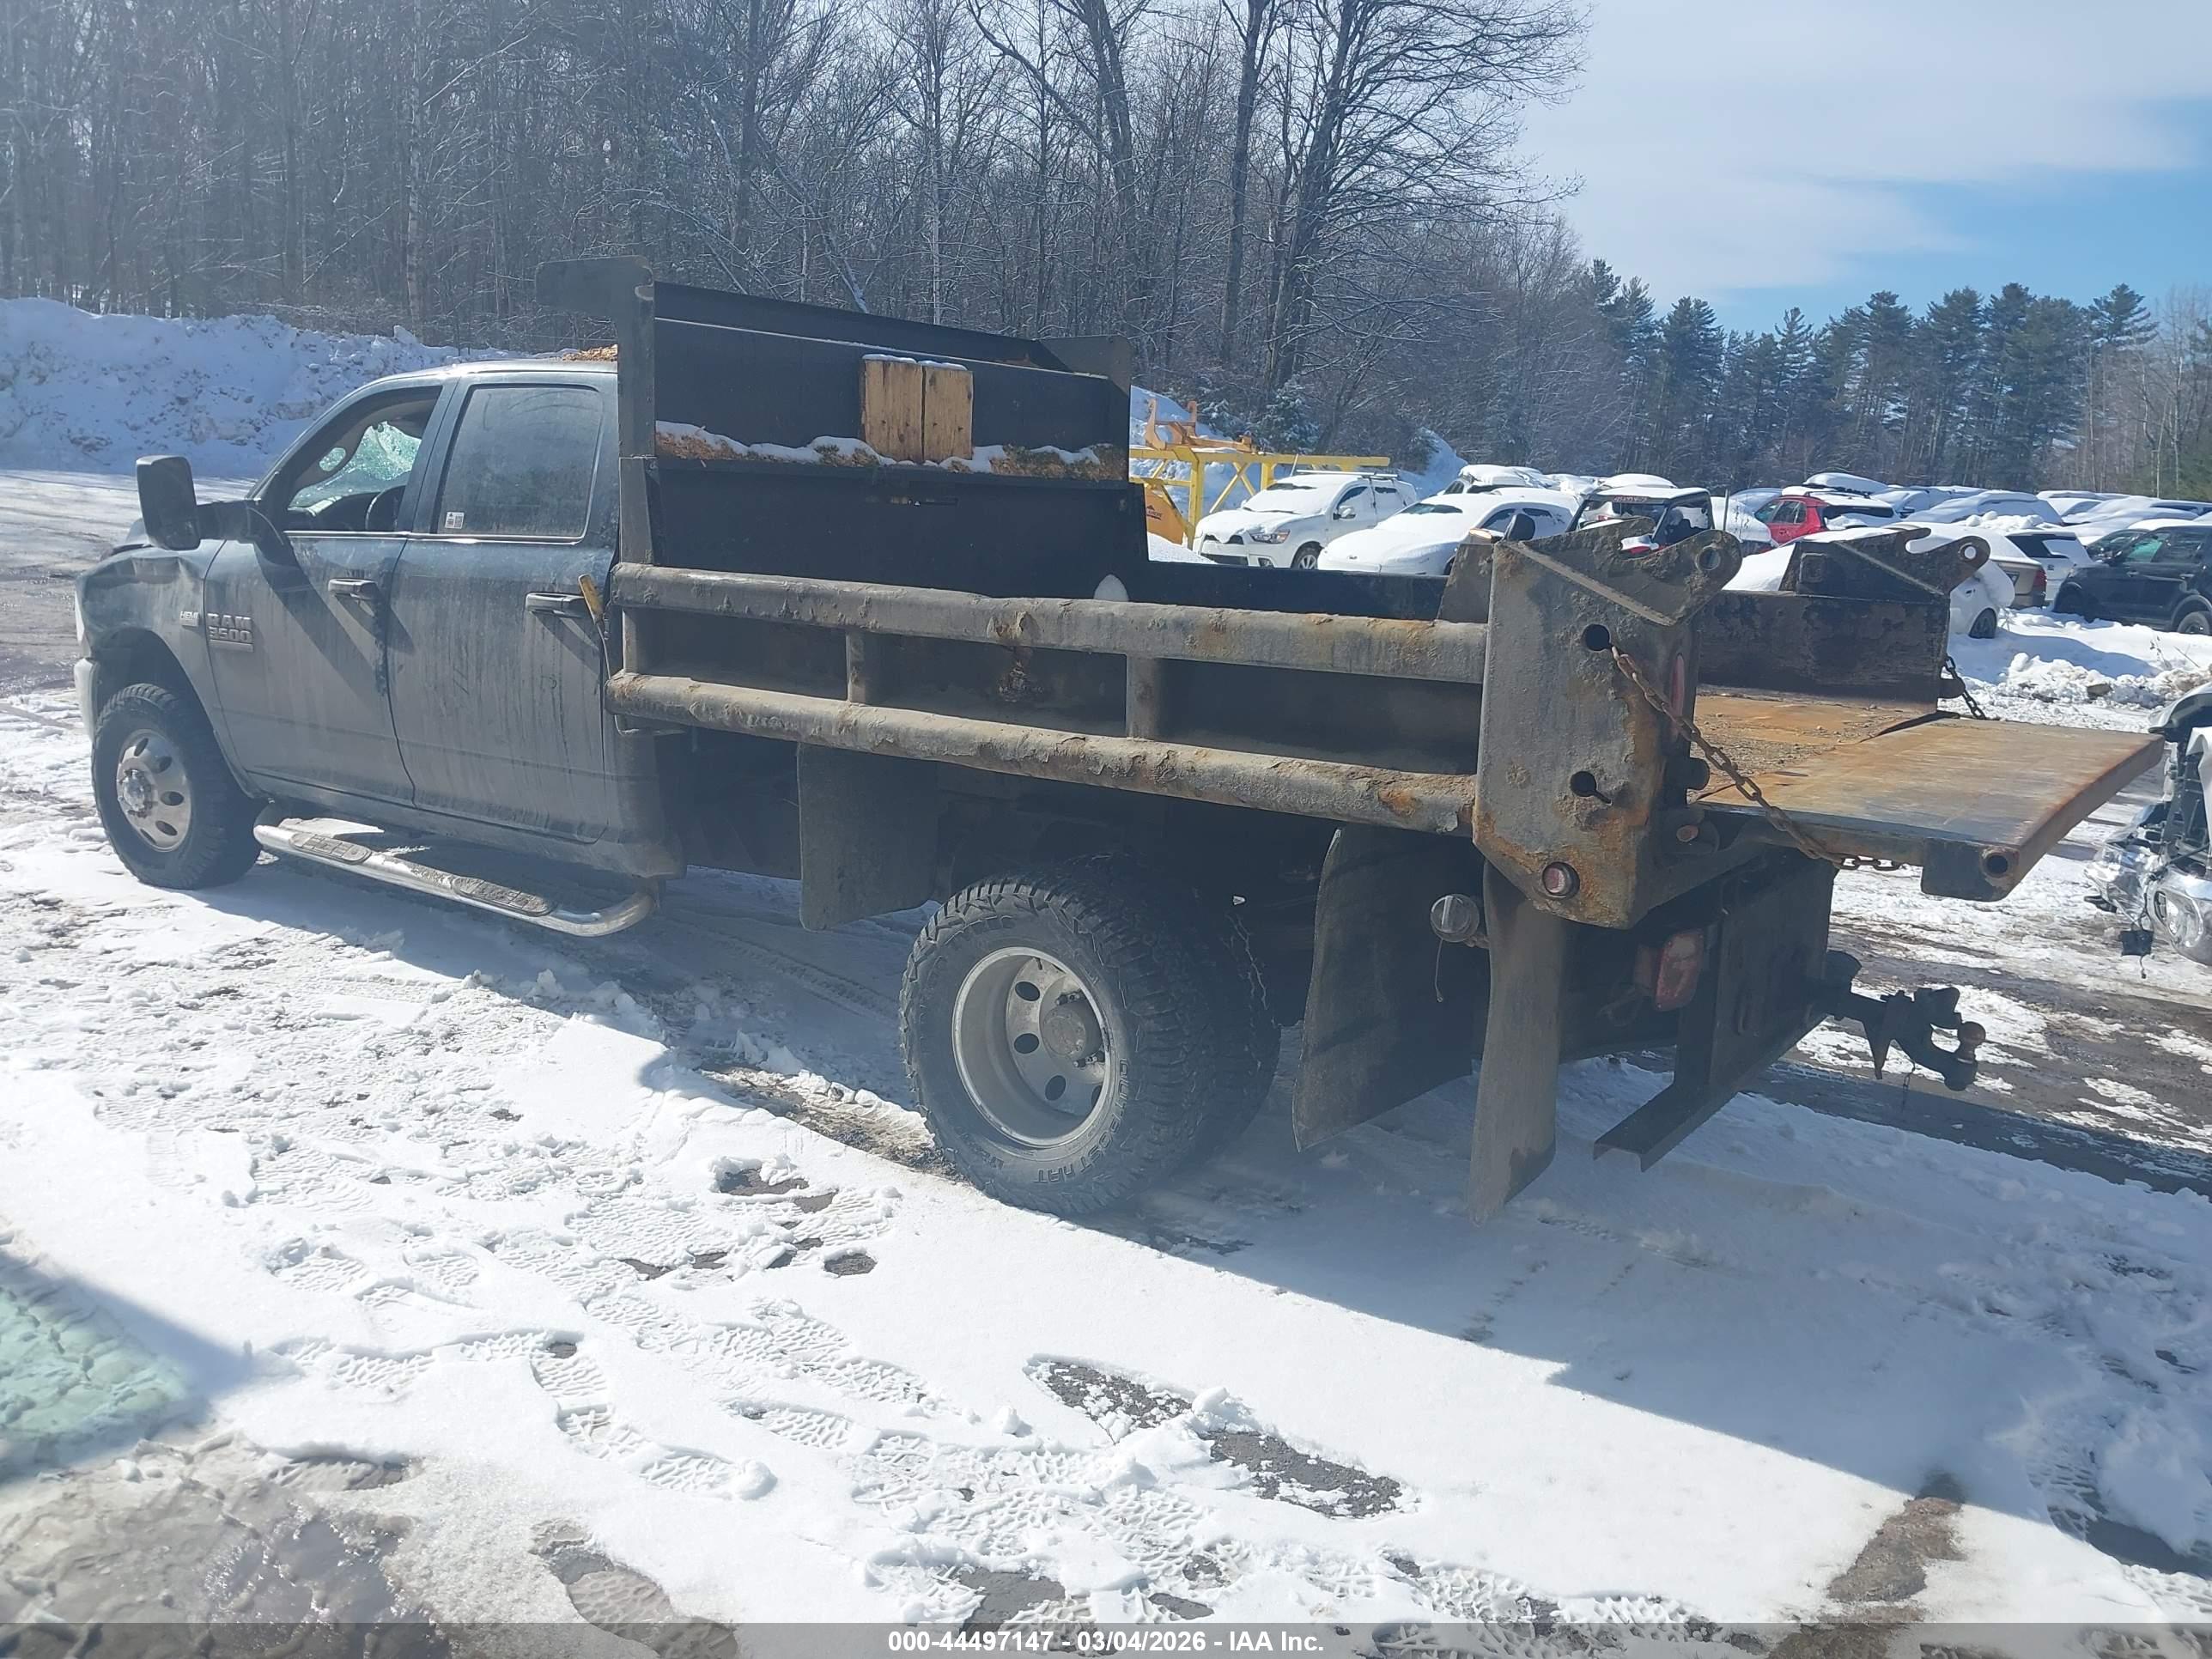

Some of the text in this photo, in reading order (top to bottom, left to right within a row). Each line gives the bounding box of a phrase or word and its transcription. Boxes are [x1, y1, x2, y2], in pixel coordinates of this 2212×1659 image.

[179, 611, 199, 621] HEMI
[207, 612, 252, 631] RAM
[209, 626, 252, 643] 3500
[1079, 1057, 1130, 1174] OUTPOST
